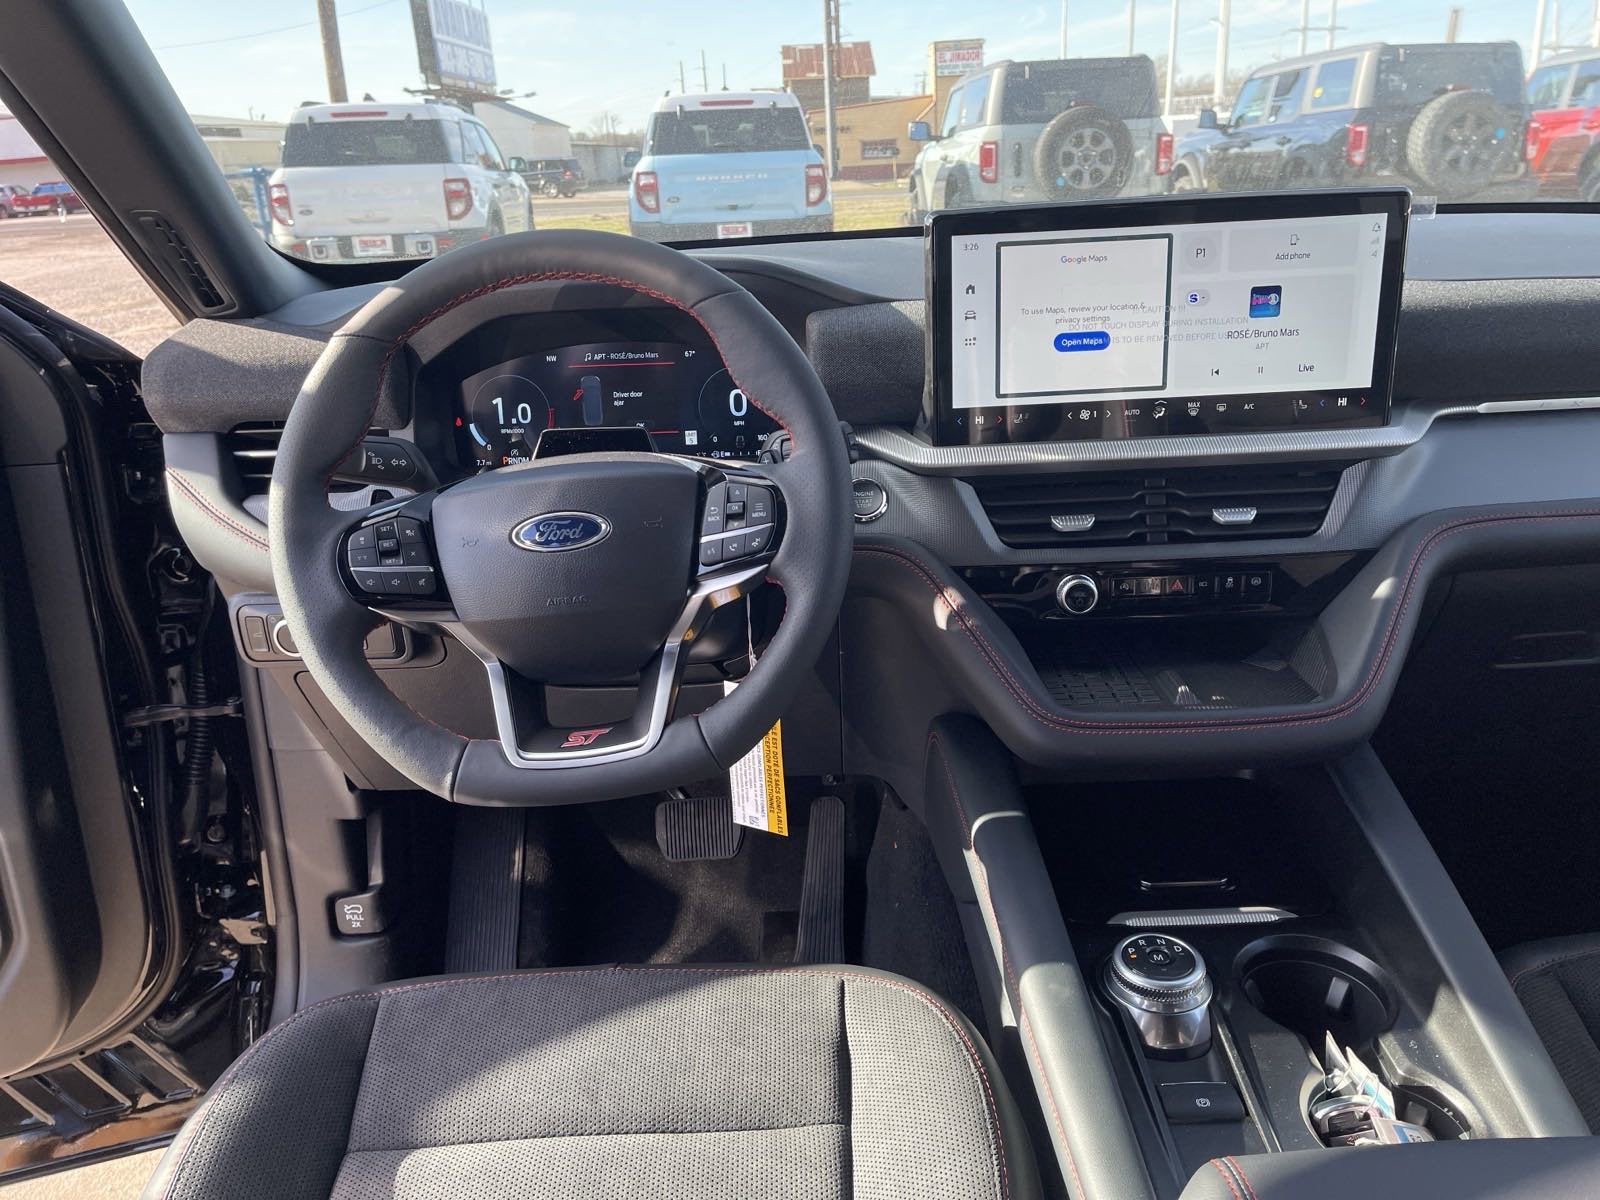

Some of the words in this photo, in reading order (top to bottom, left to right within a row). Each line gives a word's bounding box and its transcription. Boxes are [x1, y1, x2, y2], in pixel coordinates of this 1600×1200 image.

[964, 242, 979, 251] 3:26
[1195, 248, 1206, 258] P1
[1275, 252, 1289, 260] Add
[1289, 251, 1311, 261] phone
[1060, 255, 1087, 265] Google
[1088, 254, 1108, 264] Maps
[1045, 306, 1066, 316] Maps,
[1068, 305, 1091, 313] review
[1092, 304, 1108, 314] your
[1055, 317, 1081, 326] privacy
[1082, 315, 1111, 325] settings
[1128, 320, 1160, 329] DISPLAY
[1280, 327, 1300, 338] Mars
[1061, 338, 1081, 348] Open
[1082, 337, 1103, 347] Maps
[1255, 342, 1269, 350] APT
[593, 353, 606, 361] APT
[645, 351, 659, 359] Mars
[1298, 363, 1315, 373] Live
[729, 388, 748, 417] 0
[1337, 397, 1348, 406] HI
[491, 397, 532, 425] 1.0
[975, 415, 984, 425] HI
[535, 519, 584, 542] Ford
[560, 727, 614, 748] ST
